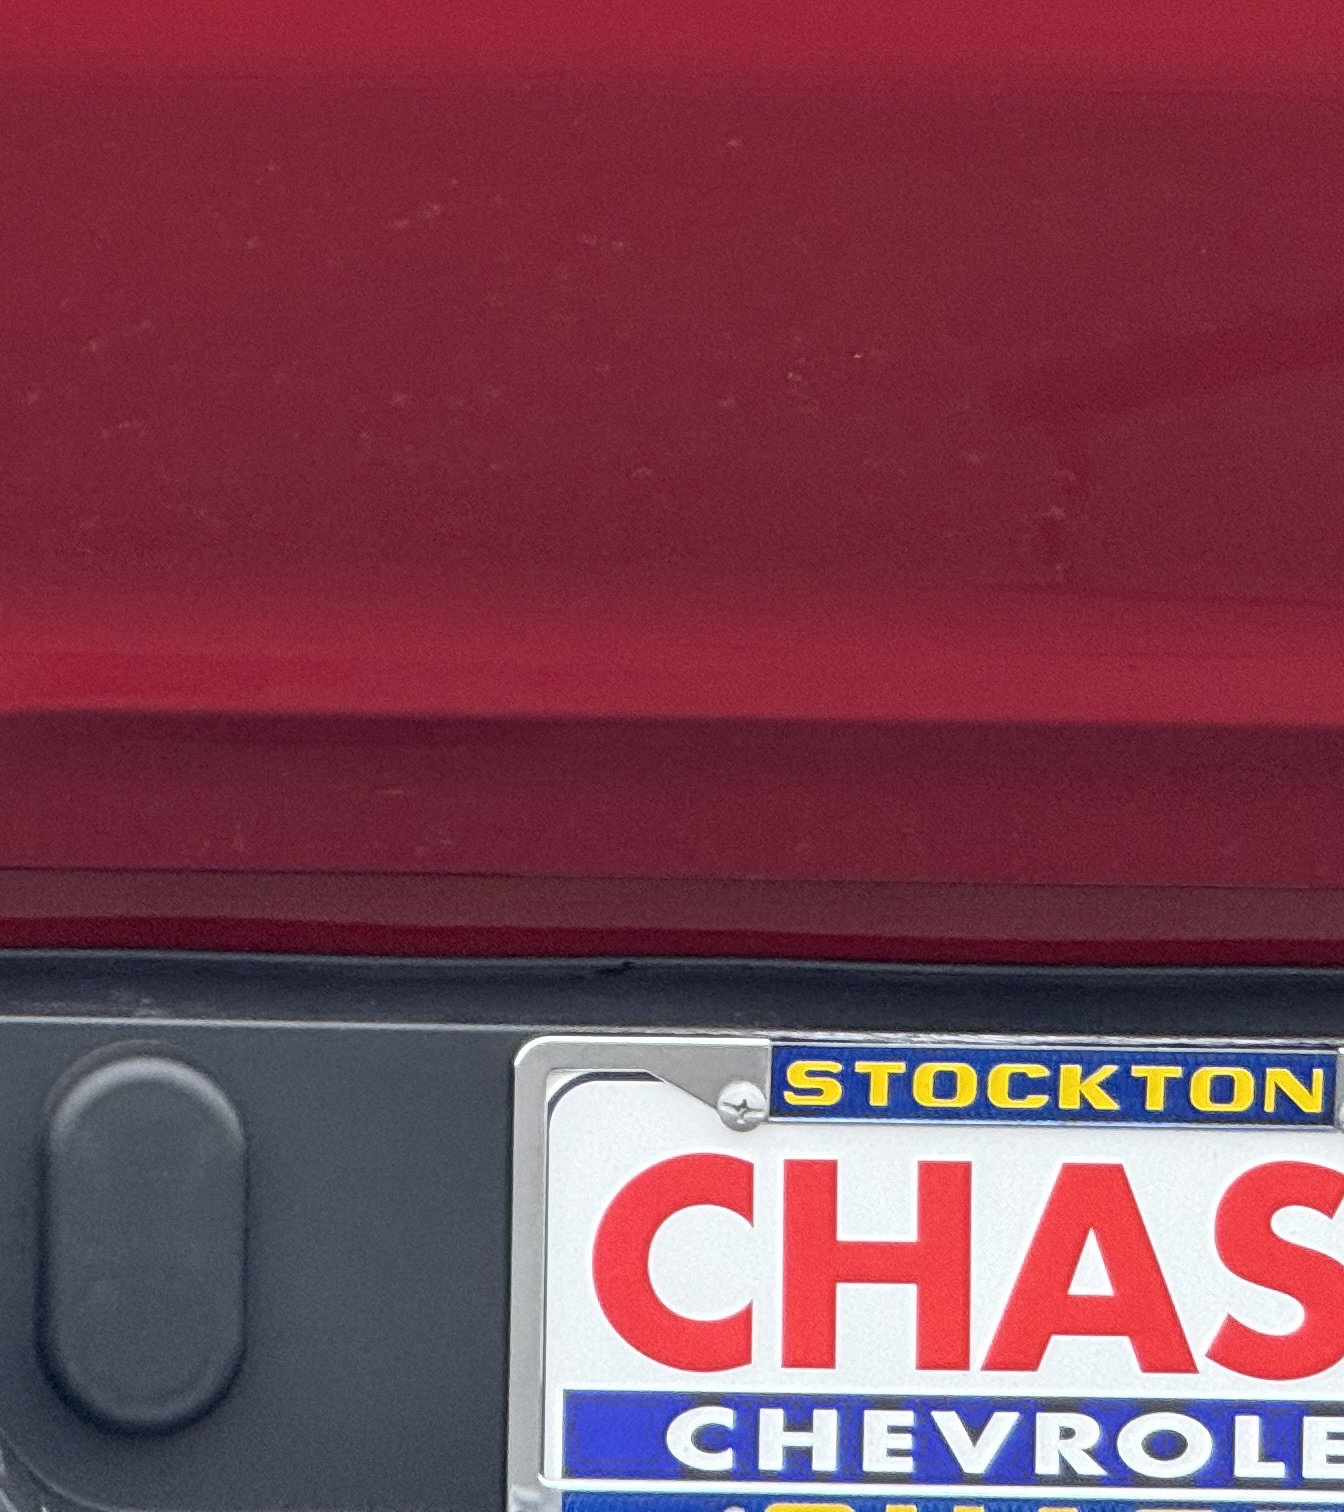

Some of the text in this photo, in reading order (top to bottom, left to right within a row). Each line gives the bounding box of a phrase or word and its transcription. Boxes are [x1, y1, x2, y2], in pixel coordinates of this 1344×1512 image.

[784, 1059, 1325, 1114] STOCKTON
[591, 1152, 1344, 1381] CHAS
[665, 1405, 1344, 1479] CHEVROLE
